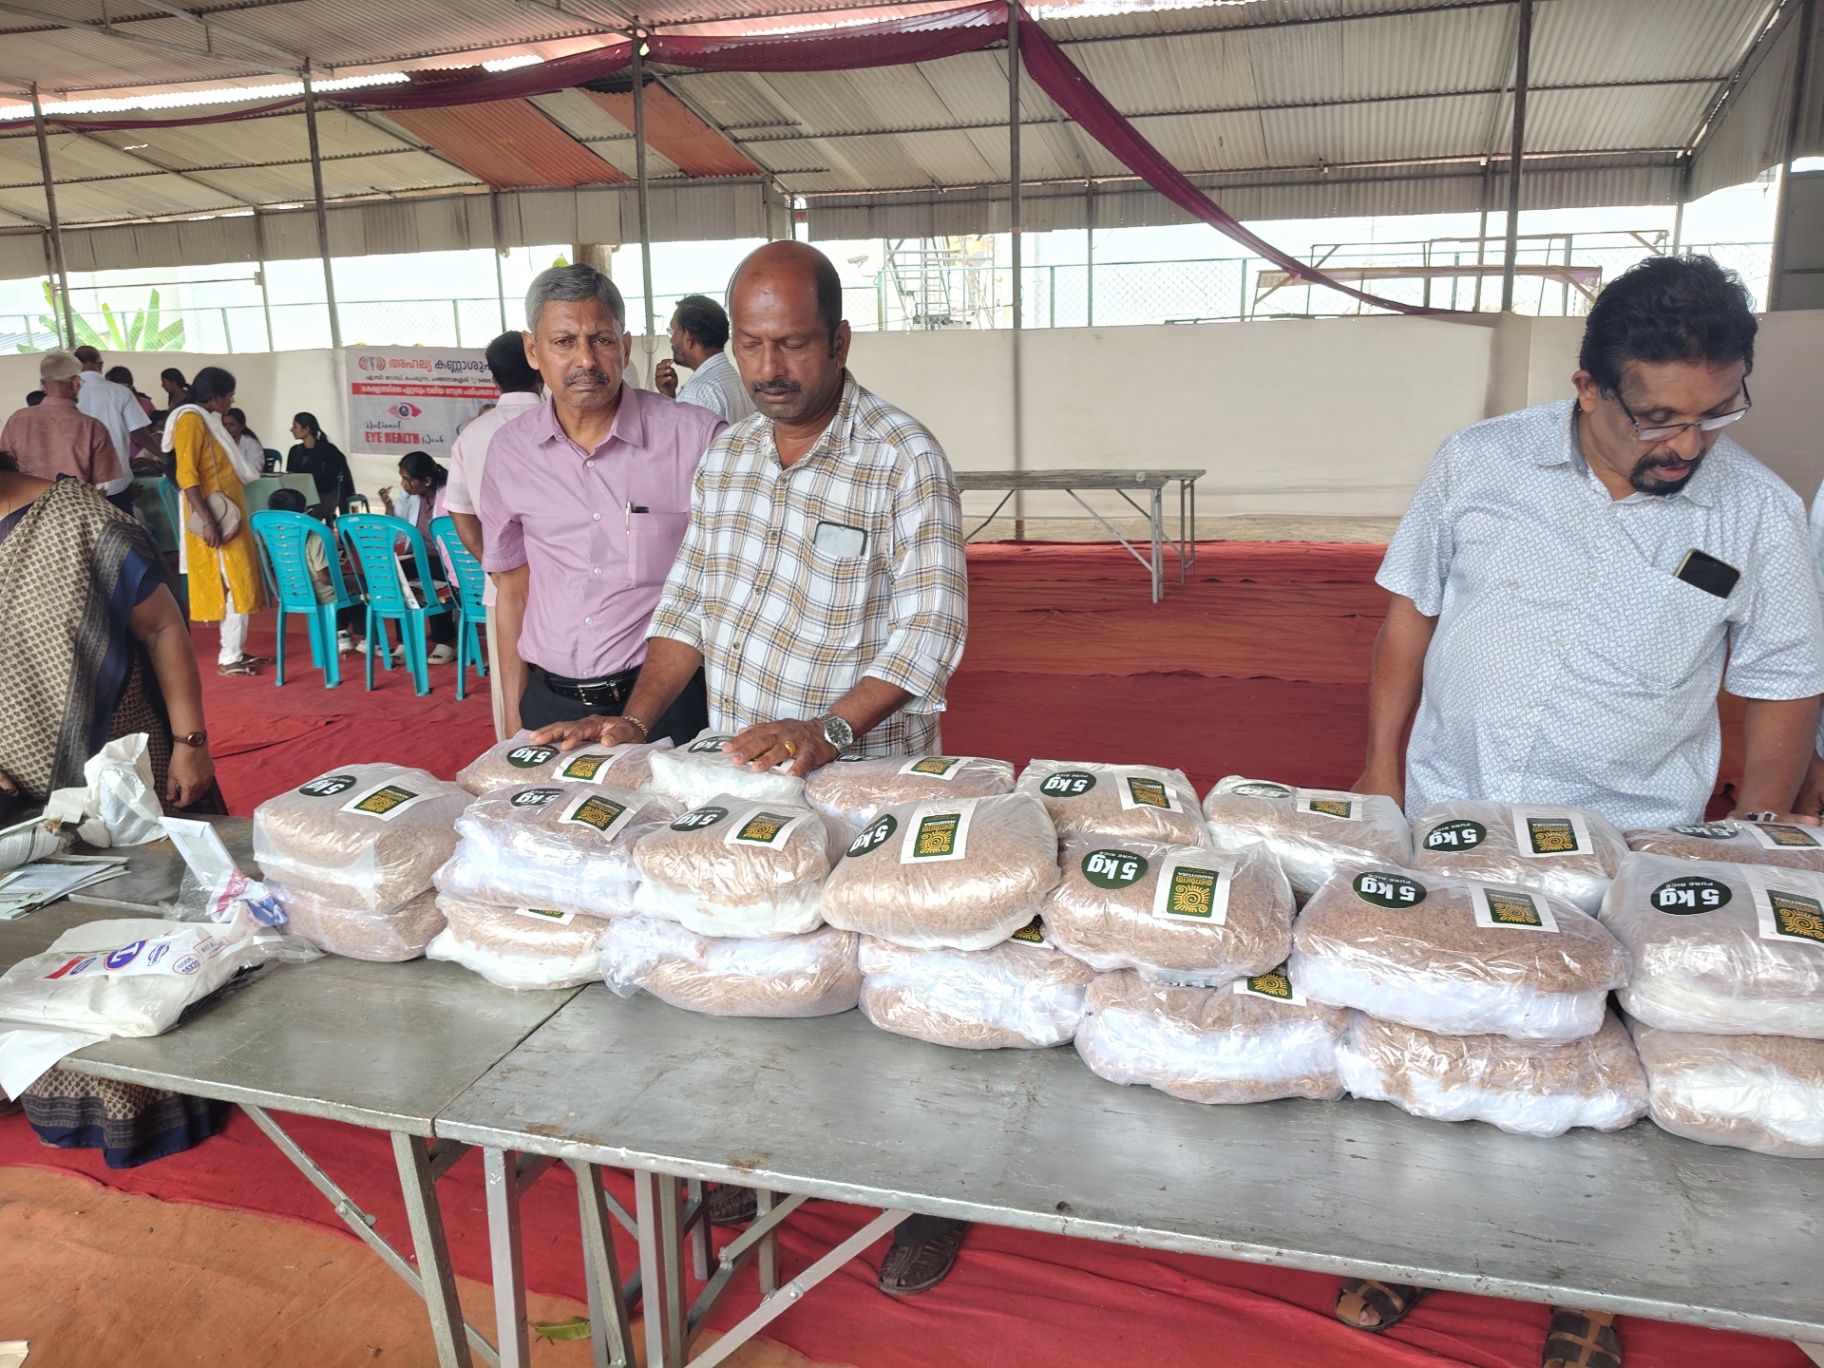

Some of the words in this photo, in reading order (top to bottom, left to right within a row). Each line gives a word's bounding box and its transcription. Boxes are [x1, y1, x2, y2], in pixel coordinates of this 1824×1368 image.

[365, 431, 382, 443] EYE
[384, 432, 419, 444] HEALTH
[511, 748, 537, 762] kg
[533, 751, 551, 762] 5
[322, 783, 345, 794] 5
[1044, 776, 1071, 792] kg
[1072, 779, 1088, 792] 5
[515, 793, 544, 804] kg
[542, 794, 561, 803] 5
[674, 813, 703, 826] kg
[698, 813, 718, 825] 5
[873, 825, 888, 843] 5
[1429, 829, 1457, 847] kg
[1462, 828, 1477, 843] 5
[849, 831, 874, 853] kg
[1086, 854, 1119, 879] kg
[1119, 861, 1138, 880] 5
[1360, 876, 1393, 900] kg
[1398, 886, 1416, 901] 5
[1659, 888, 1695, 907] kg
[1701, 888, 1719, 905] 5
